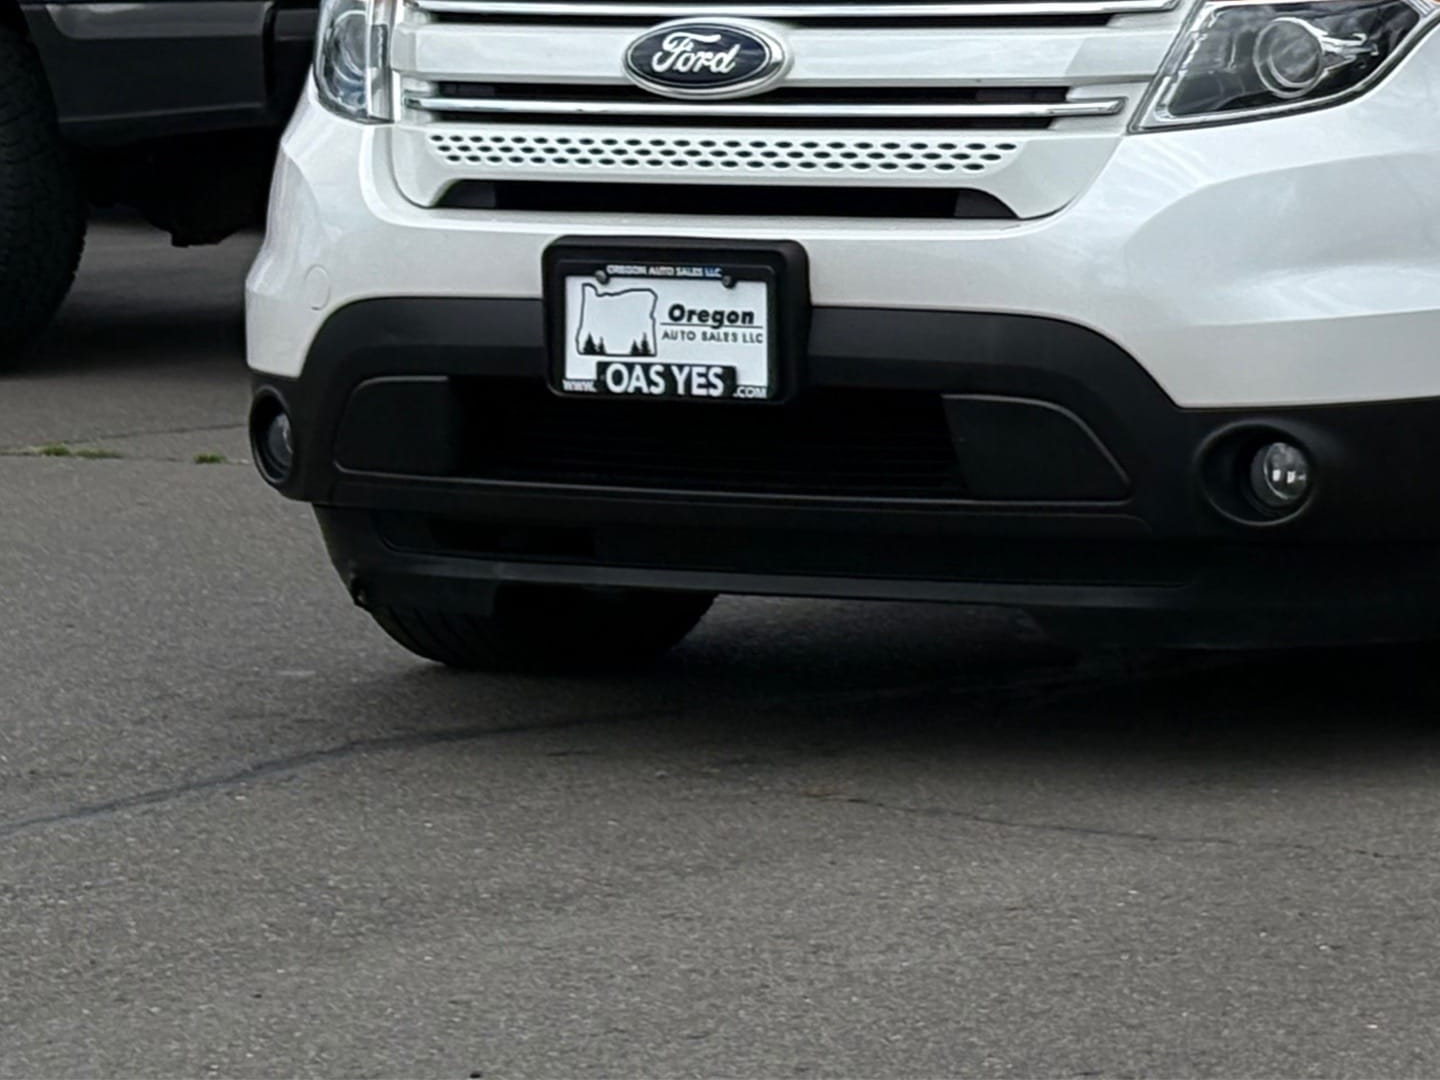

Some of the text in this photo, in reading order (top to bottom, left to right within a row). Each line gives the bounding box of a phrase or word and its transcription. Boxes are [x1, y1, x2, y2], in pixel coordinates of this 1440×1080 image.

[651, 31, 742, 74] Ford
[605, 264, 723, 278] OREGON AUTO SALES LLC
[668, 303, 755, 330] Oregon
[661, 330, 764, 344] AUTO SALES LLC
[605, 362, 666, 395] OAS
[670, 365, 725, 397] YES
